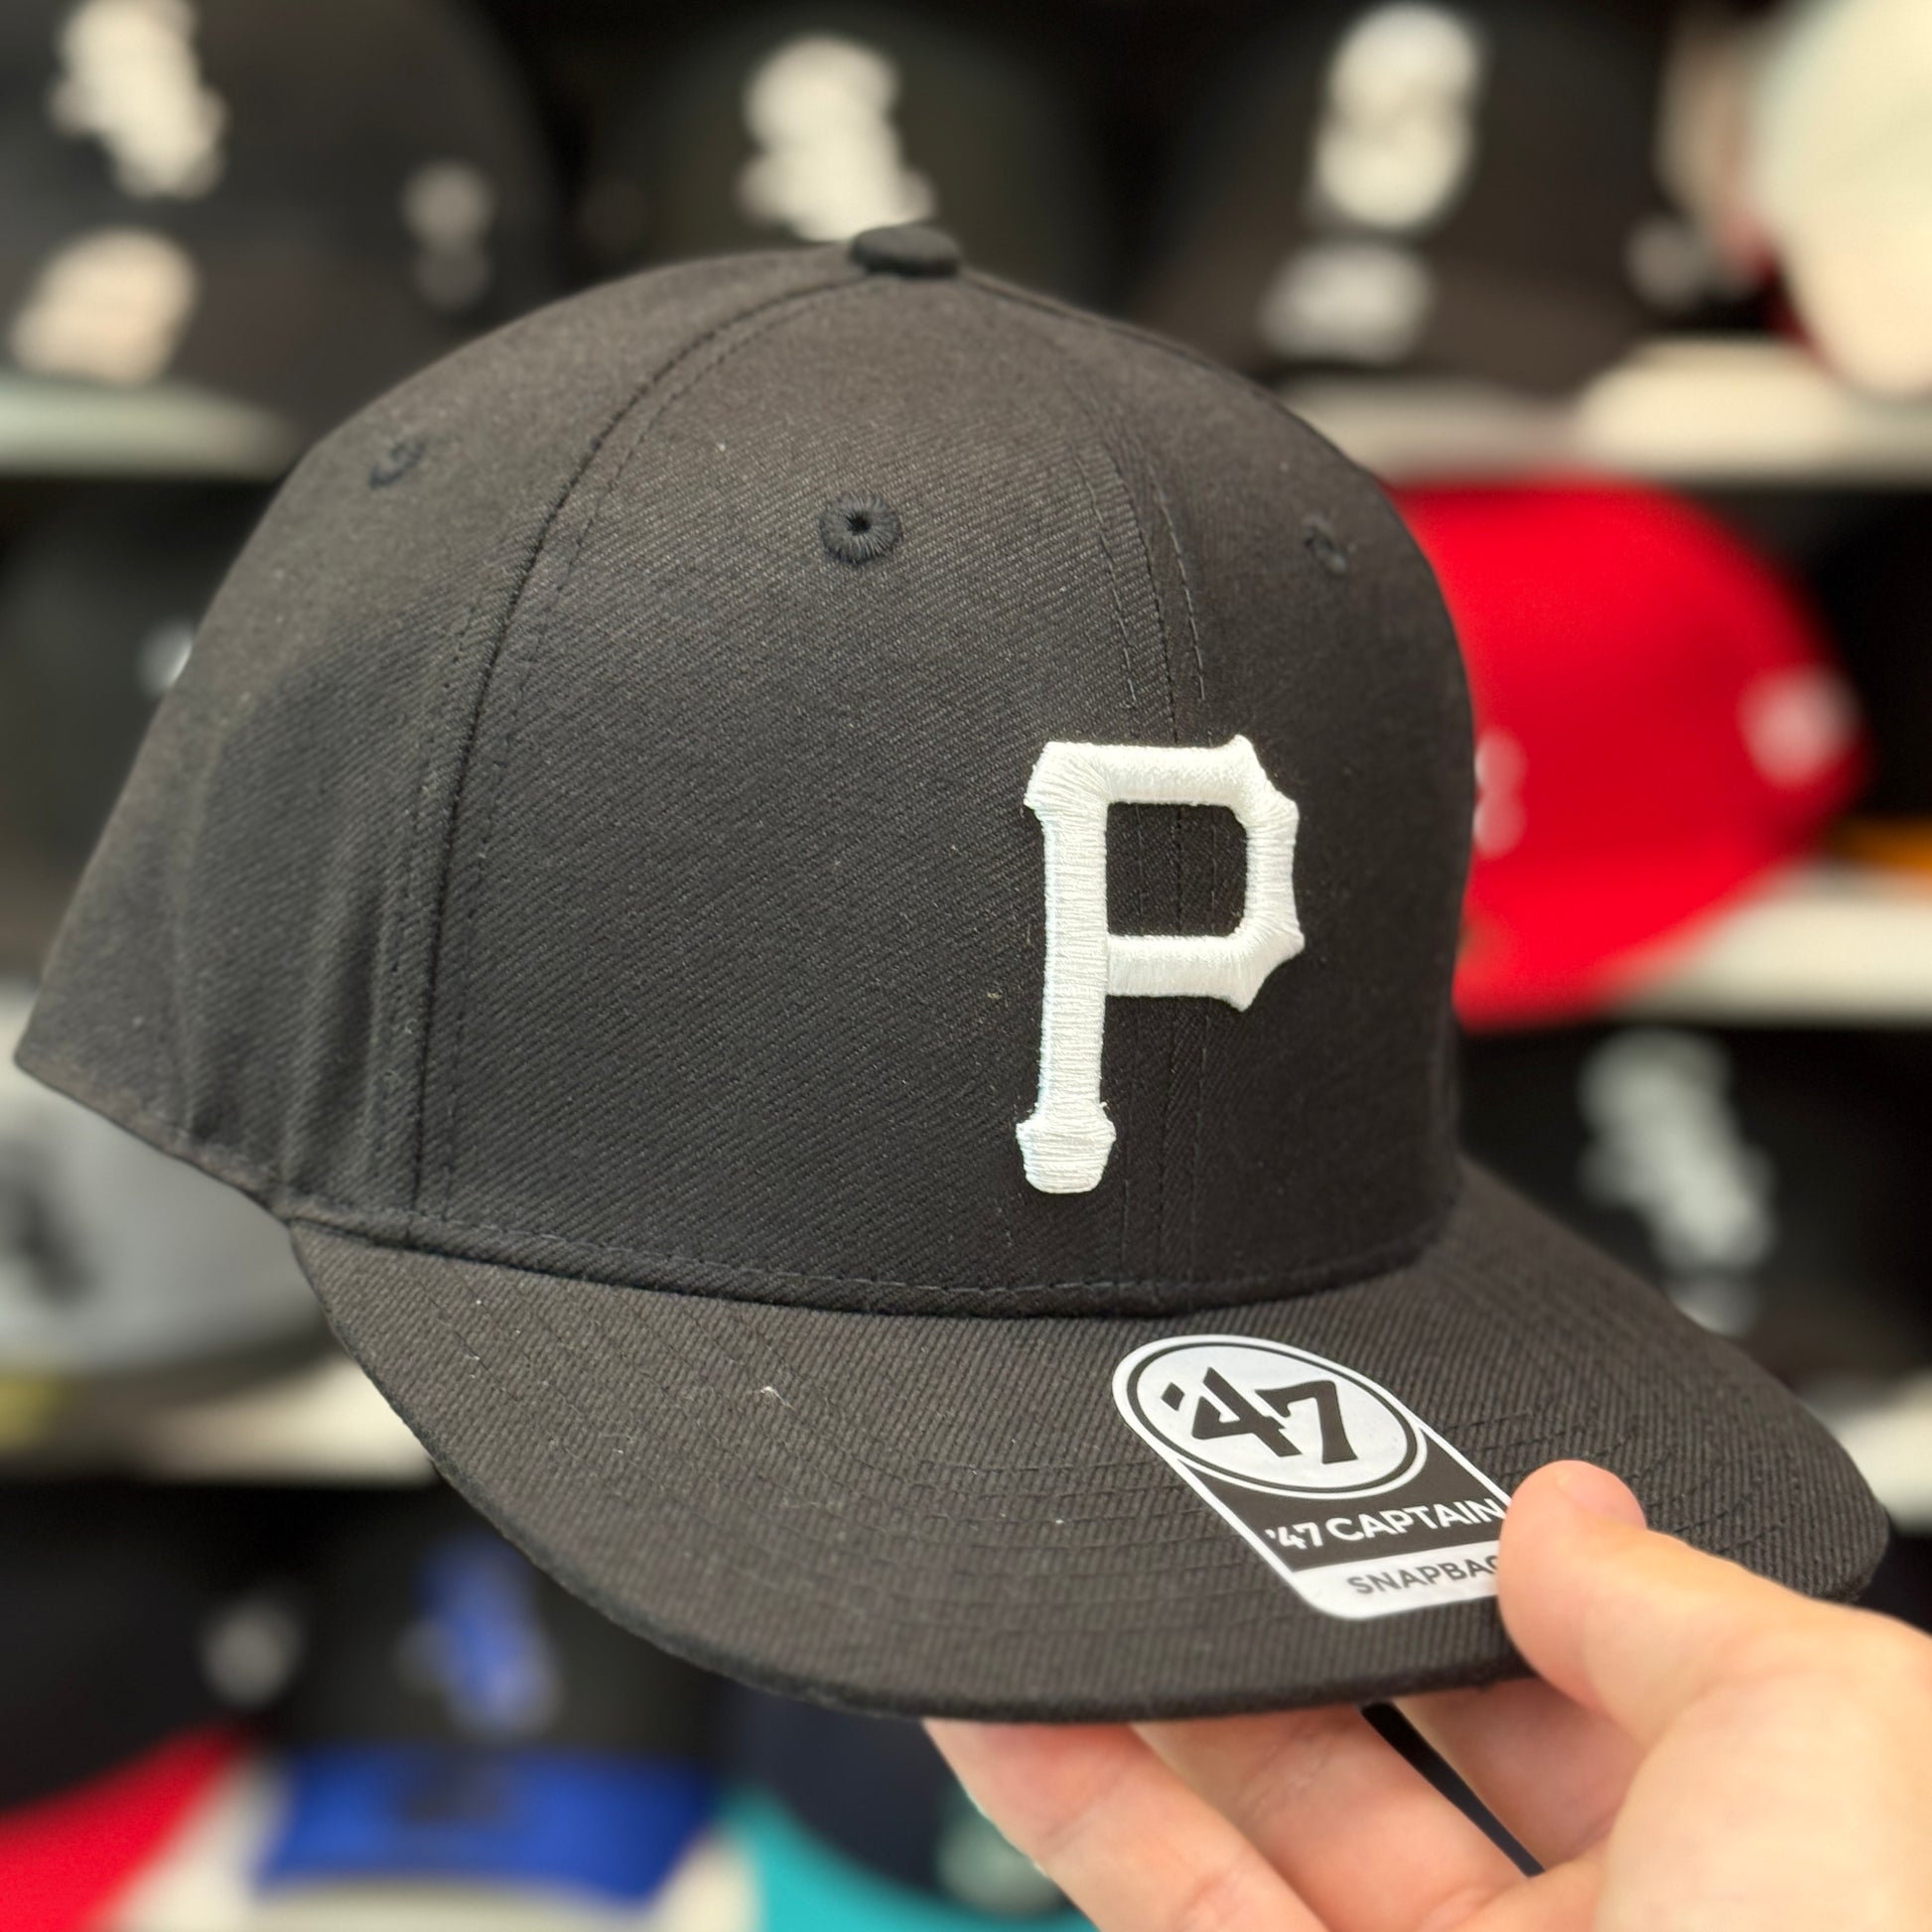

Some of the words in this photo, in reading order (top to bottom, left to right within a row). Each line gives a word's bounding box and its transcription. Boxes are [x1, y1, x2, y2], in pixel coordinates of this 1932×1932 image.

[1017, 735, 1305, 1194] P
[1265, 1522, 1323, 1550] '47
[1325, 1498, 1506, 1542] CAPTAIN
